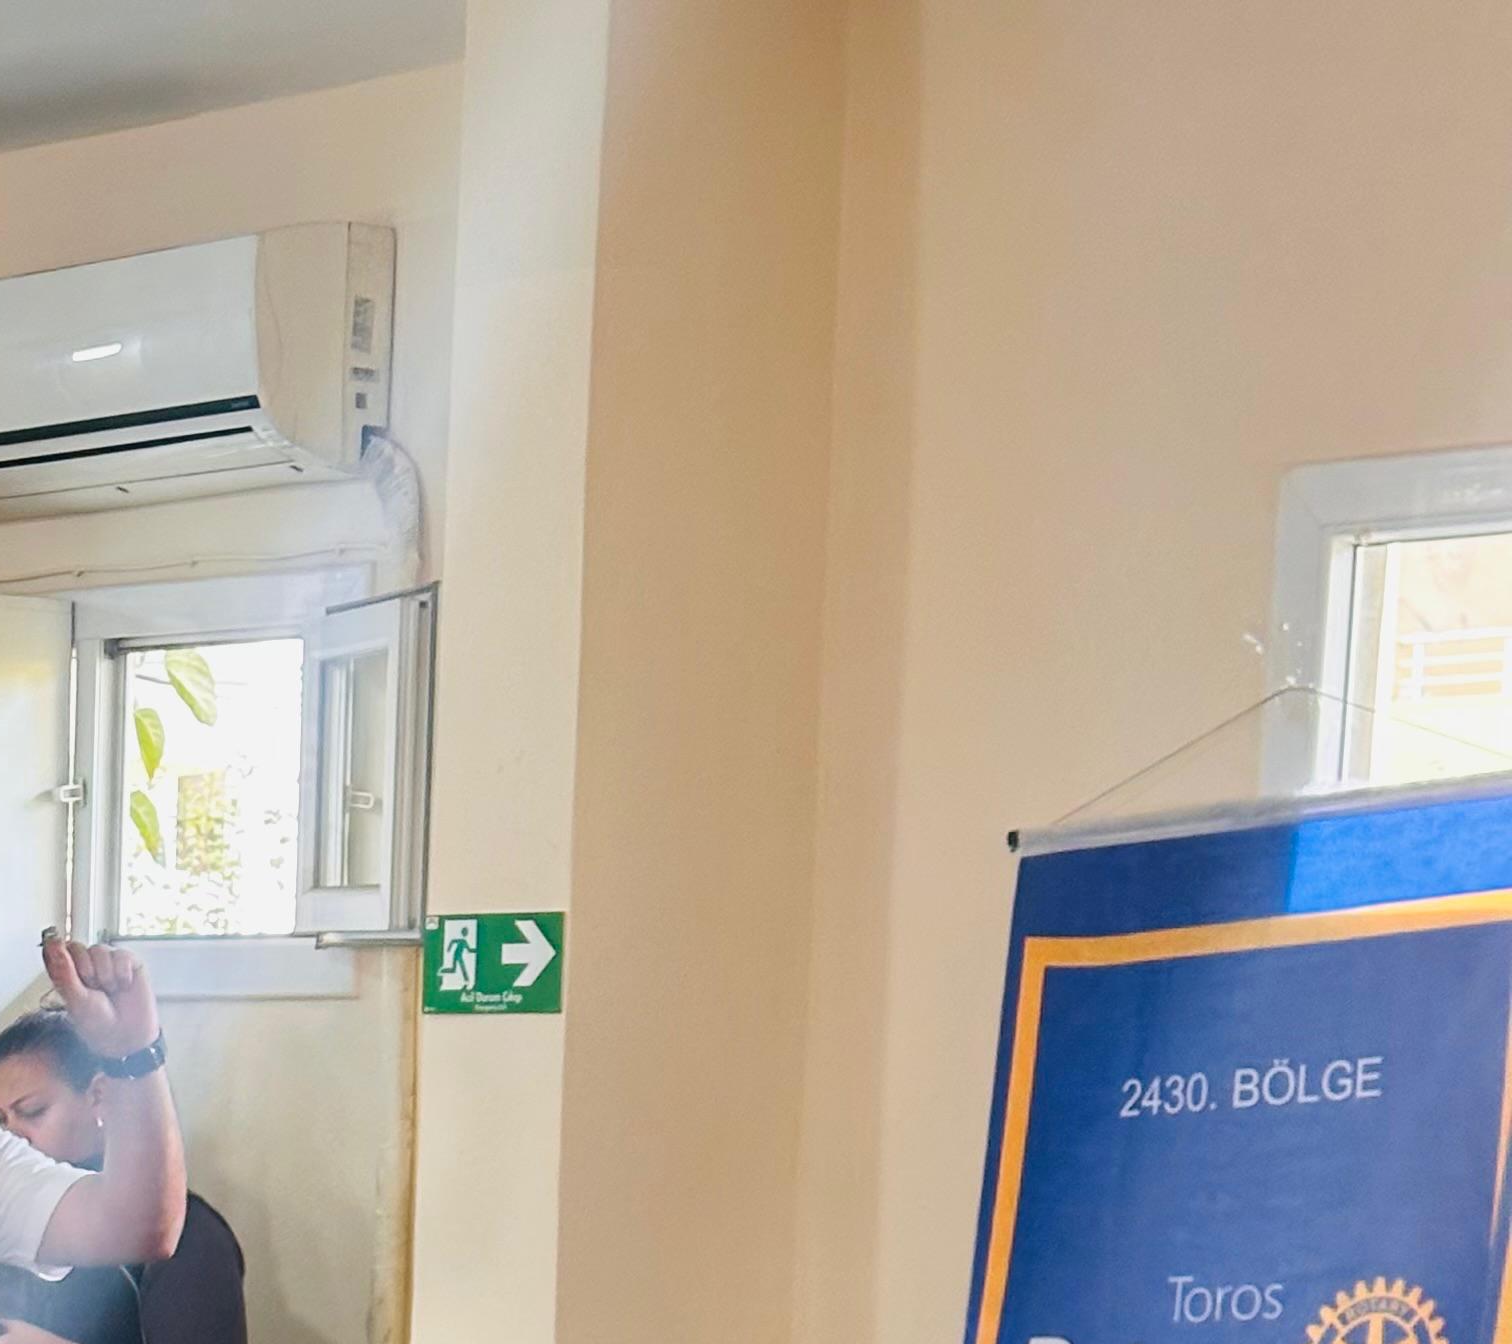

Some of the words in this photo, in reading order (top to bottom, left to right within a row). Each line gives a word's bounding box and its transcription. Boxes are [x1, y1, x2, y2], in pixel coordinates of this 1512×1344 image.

[1119, 1071, 1218, 1118] 2430.
[1232, 1056, 1385, 1109] BÖLGE
[1168, 1276, 1285, 1324] Toros
